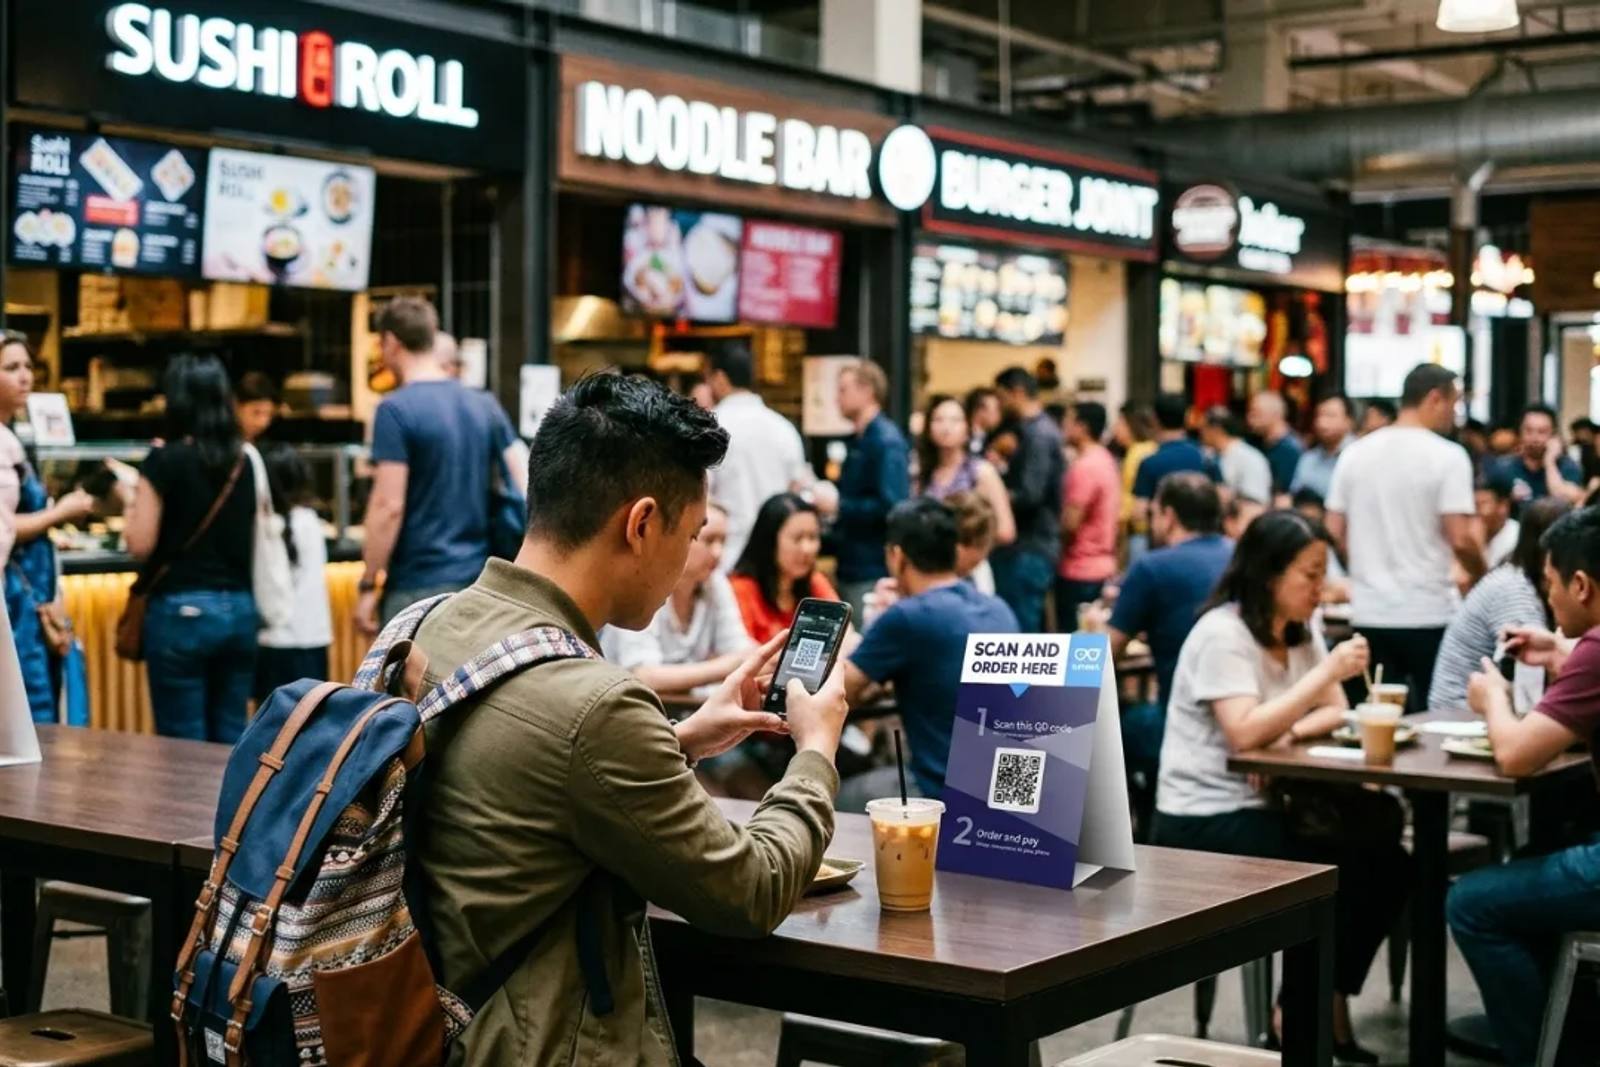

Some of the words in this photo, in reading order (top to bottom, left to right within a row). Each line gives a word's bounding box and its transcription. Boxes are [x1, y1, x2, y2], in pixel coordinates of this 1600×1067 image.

[107, 2, 298, 98] SUSHI
[336, 41, 478, 128] ROLL
[576, 80, 778, 184] NOODLE
[779, 118, 872, 200] BAR
[941, 150, 1073, 227] BURGER
[1073, 176, 1159, 239] JOINT
[974, 642, 1019, 657] SCAN
[1022, 642, 1060, 657] AND
[972, 661, 1018, 674] ORDER
[1021, 662, 1058, 675] HERE
[977, 707, 987, 736] 1
[993, 719, 1015, 730] Scan
[1016, 720, 1033, 731] this
[1049, 724, 1073, 734] code
[952, 816, 974, 846] 2
[976, 828, 1003, 841] Order
[1022, 837, 1039, 848] pay
